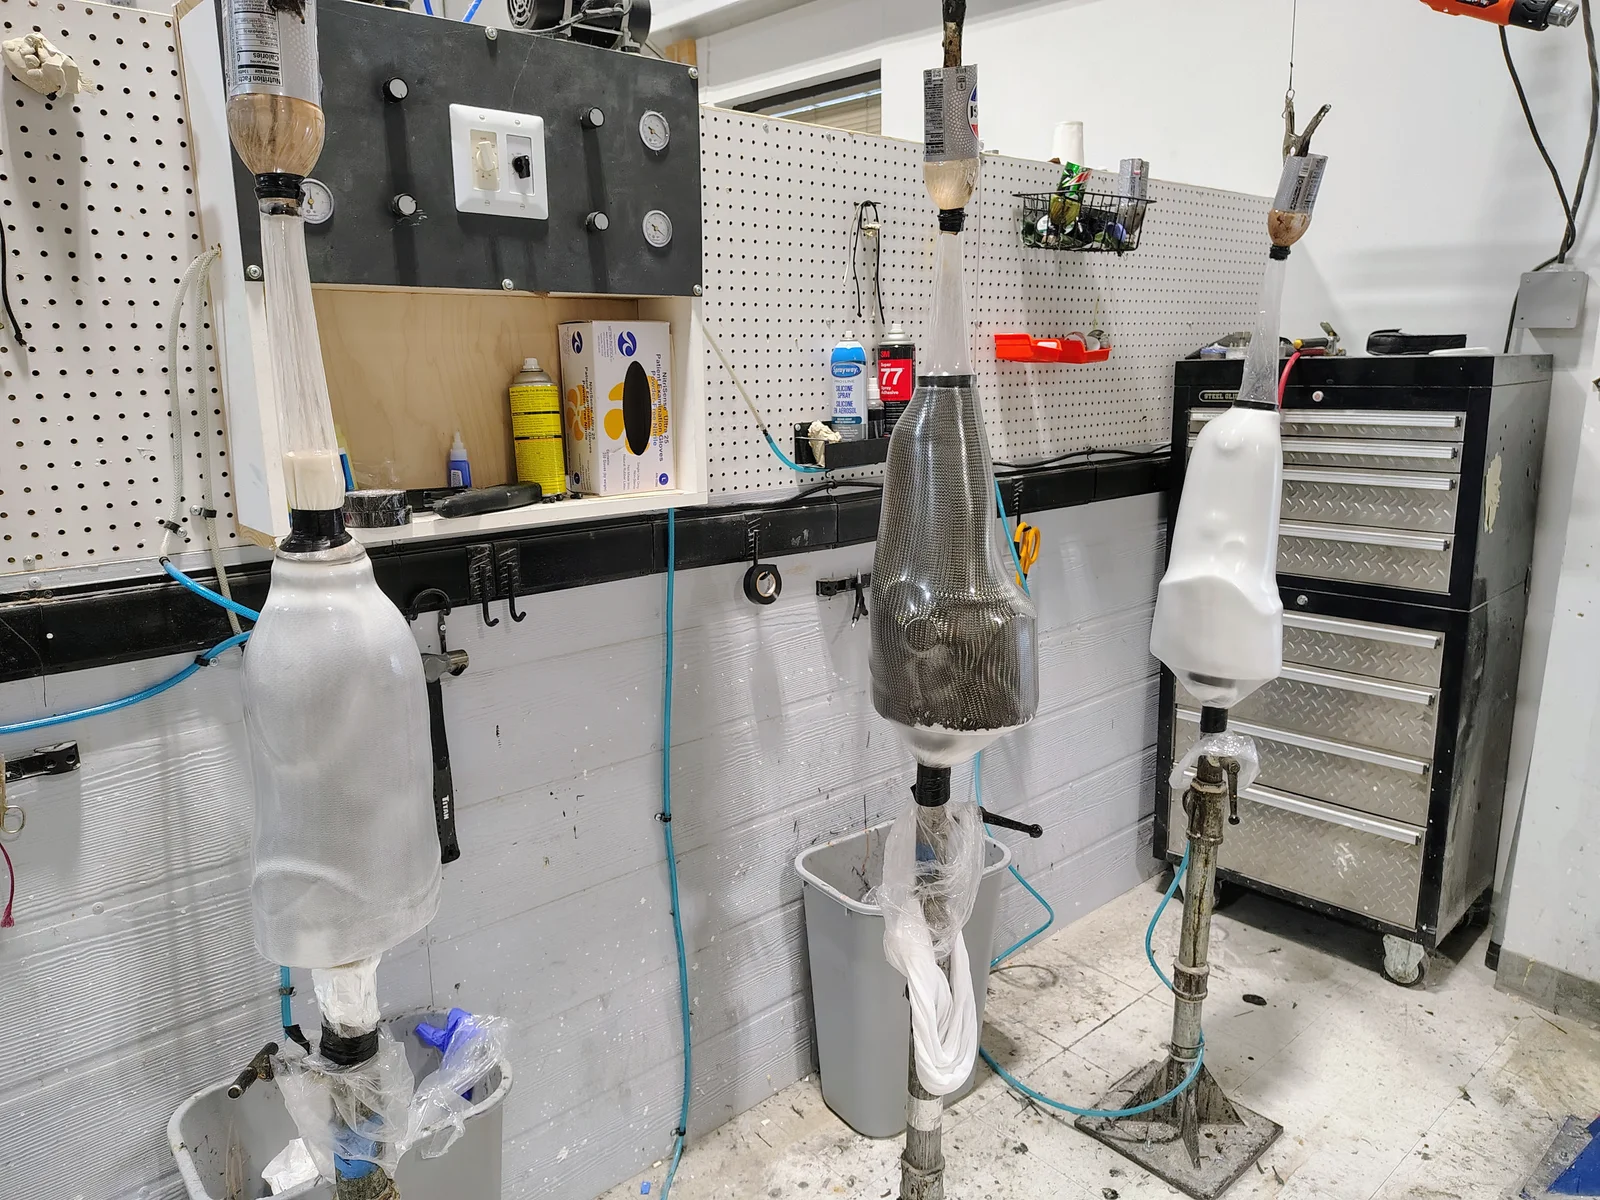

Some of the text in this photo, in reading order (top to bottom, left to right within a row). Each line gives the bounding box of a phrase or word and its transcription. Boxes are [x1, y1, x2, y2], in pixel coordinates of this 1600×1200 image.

[252, 53, 279, 61] Calories
[252, 76, 280, 84] Nutrition
[881, 368, 903, 385] 77
[664, 434, 669, 444] 25
